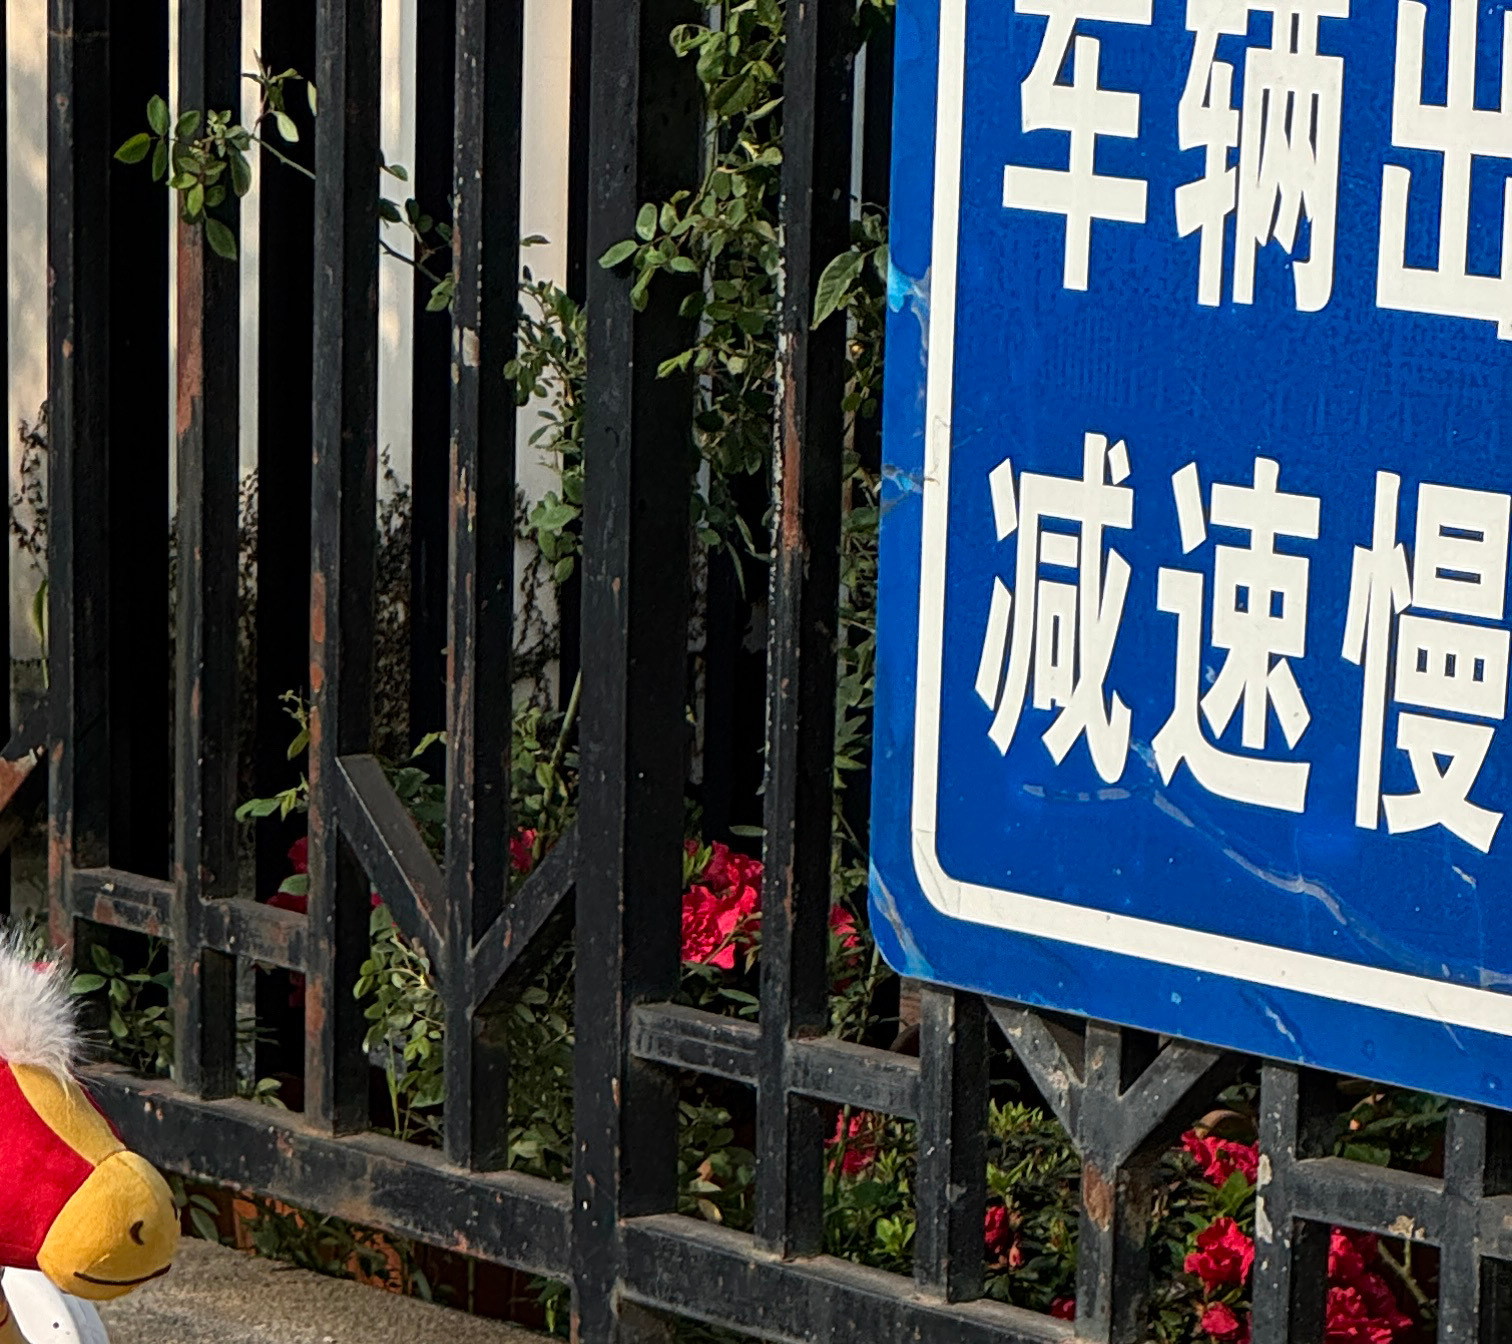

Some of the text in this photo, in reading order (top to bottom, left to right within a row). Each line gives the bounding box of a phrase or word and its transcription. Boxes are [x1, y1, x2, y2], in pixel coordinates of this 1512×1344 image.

[1002, 0, 1512, 341] 车辆出
[975, 432, 1512, 854] 减速慢
